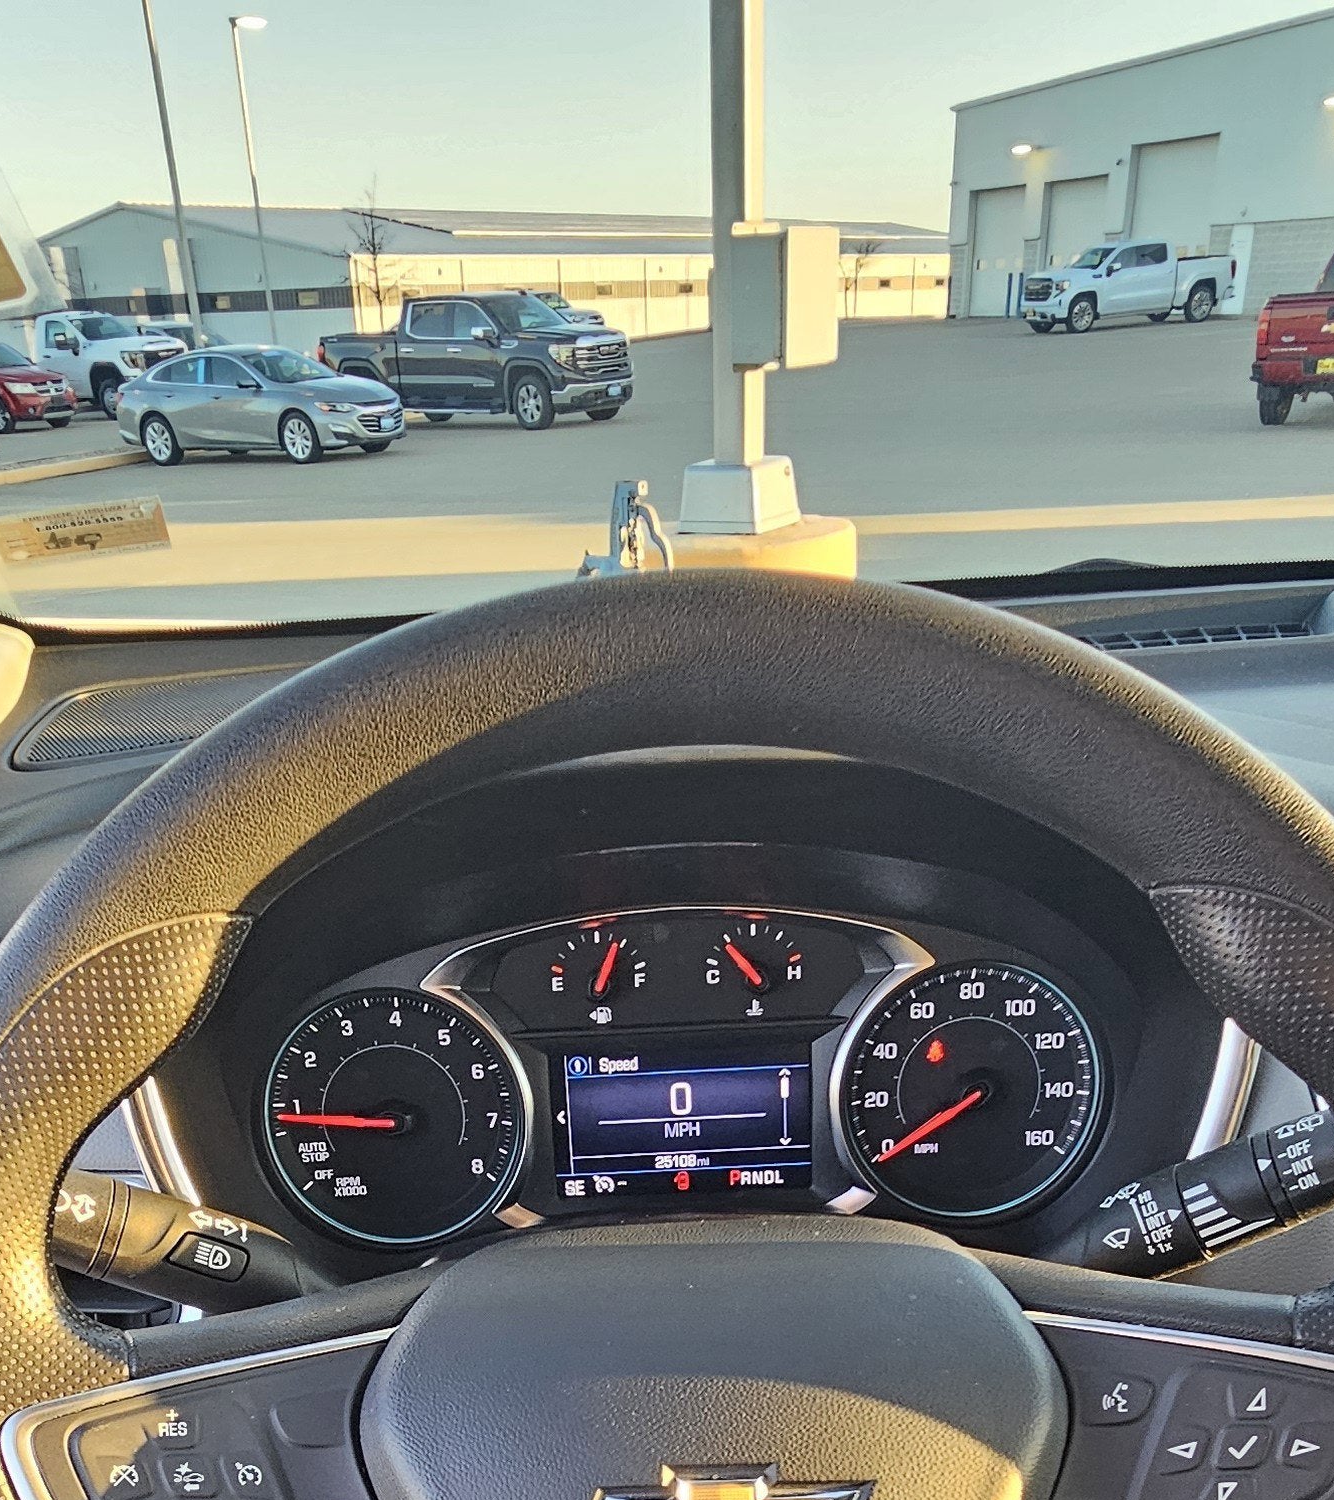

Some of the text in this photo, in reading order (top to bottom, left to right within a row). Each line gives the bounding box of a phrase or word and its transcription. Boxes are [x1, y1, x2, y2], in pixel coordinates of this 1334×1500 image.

[634, 973, 646, 988] F
[706, 970, 720, 984] C
[787, 966, 801, 980] H
[552, 977, 564, 991] E
[960, 982, 985, 1000] 80
[910, 1002, 935, 1019] 60
[1004, 999, 1036, 1017] 100
[389, 1011, 402, 1027] 4
[340, 1020, 353, 1036] 3
[437, 1029, 450, 1046] 5
[1035, 1032, 1065, 1050] 120
[873, 1042, 898, 1059] 40
[304, 1052, 317, 1068] 2
[598, 1057, 639, 1075] Speed
[471, 1064, 484, 1080] 6
[1044, 1081, 1074, 1098] 140
[670, 1081, 693, 1116] 0
[864, 1091, 889, 1108] 20
[292, 1100, 301, 1115] 1
[486, 1113, 498, 1128] 7
[664, 1122, 701, 1138] MPH
[1025, 1129, 1055, 1146] 160
[298, 1142, 327, 1153] AUTO
[881, 1138, 895, 1154] 0
[914, 1143, 939, 1154] MPH
[1287, 1138, 1311, 1159] OFF
[301, 1152, 330, 1163] STOP
[1291, 1155, 1316, 1176] INT
[314, 1169, 334, 1180] OFF
[471, 1159, 484, 1174] 8
[335, 1176, 361, 1187] RPM
[565, 1180, 586, 1196] SE
[1297, 1172, 1321, 1191] ON
[334, 1186, 367, 1197] X1000
[1138, 1190, 1153, 1203] HI
[1141, 1200, 1159, 1217] LO
[1146, 1211, 1168, 1231] INT
[1152, 1225, 1174, 1244] OFF
[158, 1421, 188, 1438] RES
